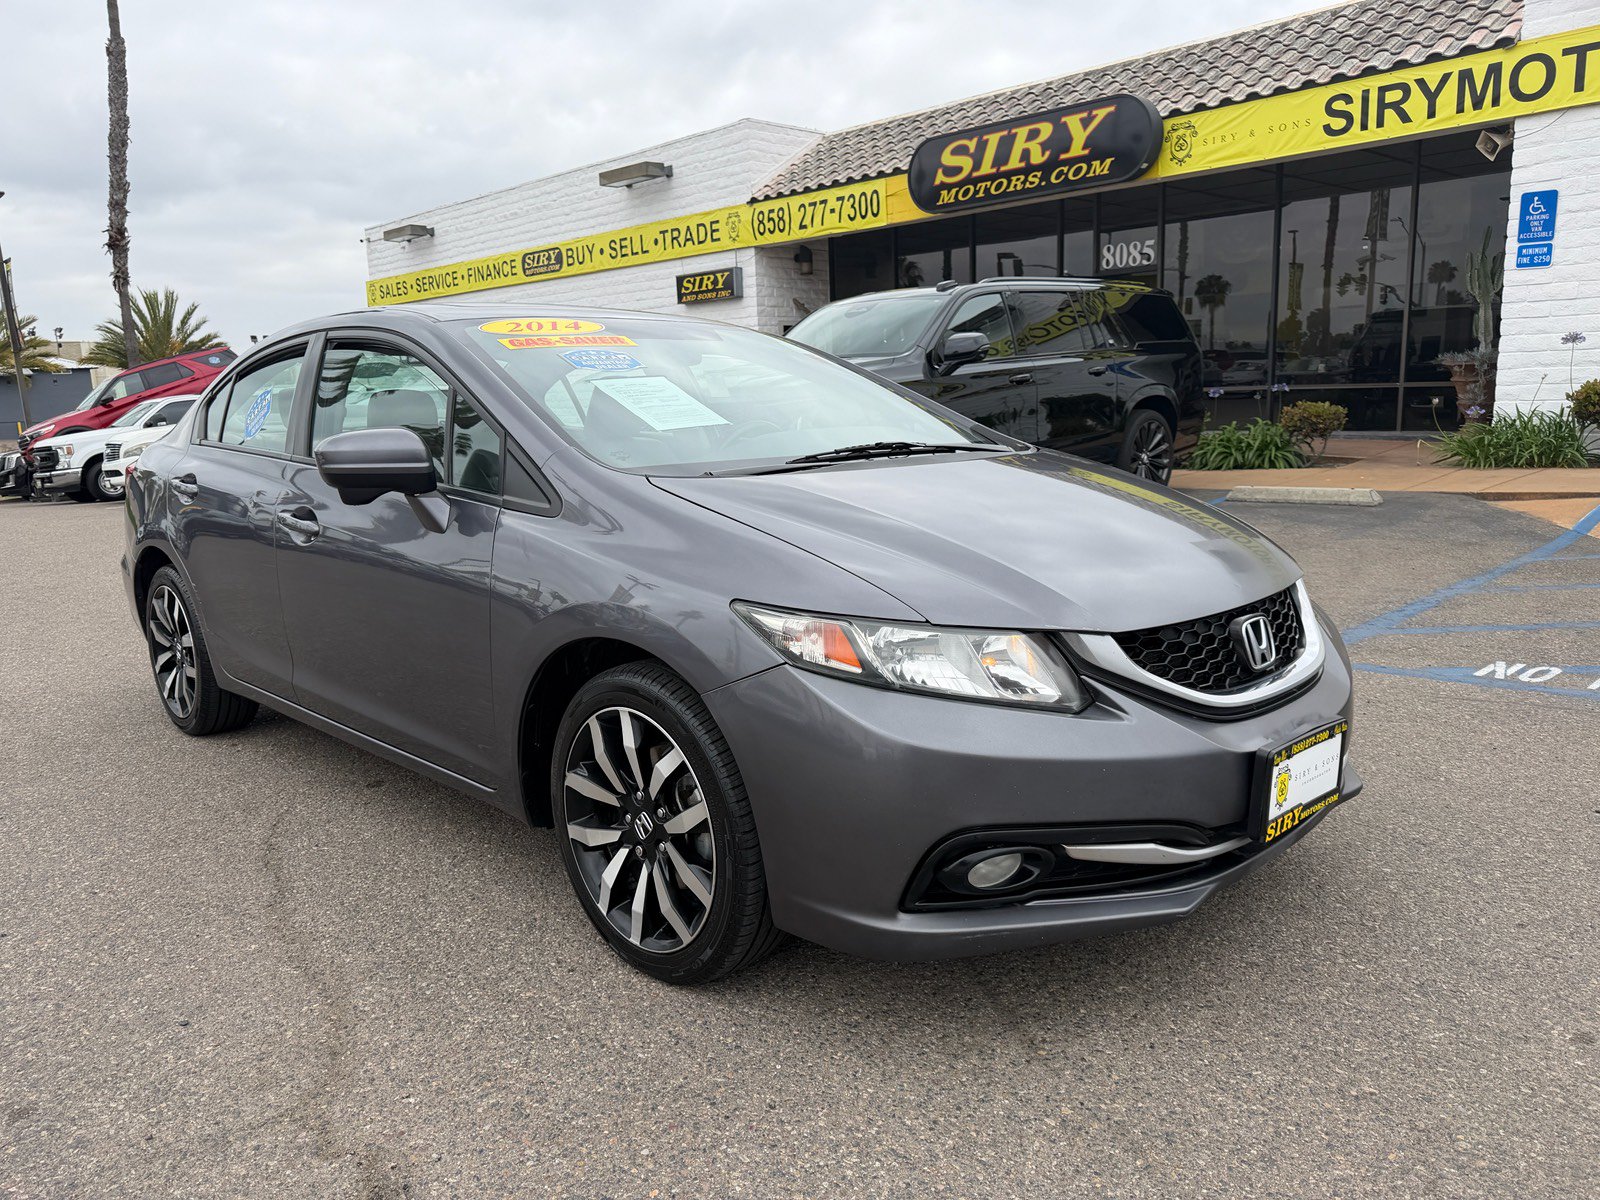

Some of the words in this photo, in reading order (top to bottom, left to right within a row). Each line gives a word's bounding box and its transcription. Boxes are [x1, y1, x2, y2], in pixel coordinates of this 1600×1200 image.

[1322, 41, 1600, 137] SIRYMOT
[933, 104, 1118, 187] SIRY
[1202, 131, 1238, 147] SIRY
[1248, 129, 1256, 138] &
[1267, 118, 1312, 134] SONS
[936, 157, 1116, 206] MOTORS.COM
[751, 202, 792, 241] (858)
[798, 189, 880, 231] 277-7300
[566, 243, 596, 267] BUY
[609, 234, 650, 260] SELL
[659, 219, 721, 251] TRADE
[1520, 231, 1552, 239] ACCESSIBLE
[524, 249, 560, 269] SIRY
[1102, 239, 1155, 270] 8085
[1533, 255, 1551, 264] $250
[379, 281, 409, 300] SALES
[416, 270, 459, 293] SERVICE
[467, 259, 518, 284] FINANCE
[681, 271, 730, 294] SIRY
[681, 294, 697, 303] AND
[697, 291, 717, 300] SONS
[717, 289, 732, 298] INC
[506, 321, 582, 333] 2014
[508, 336, 627, 347] GAS-SAVER
[1473, 661, 1563, 683] NO
[1265, 805, 1303, 843] SIRY
